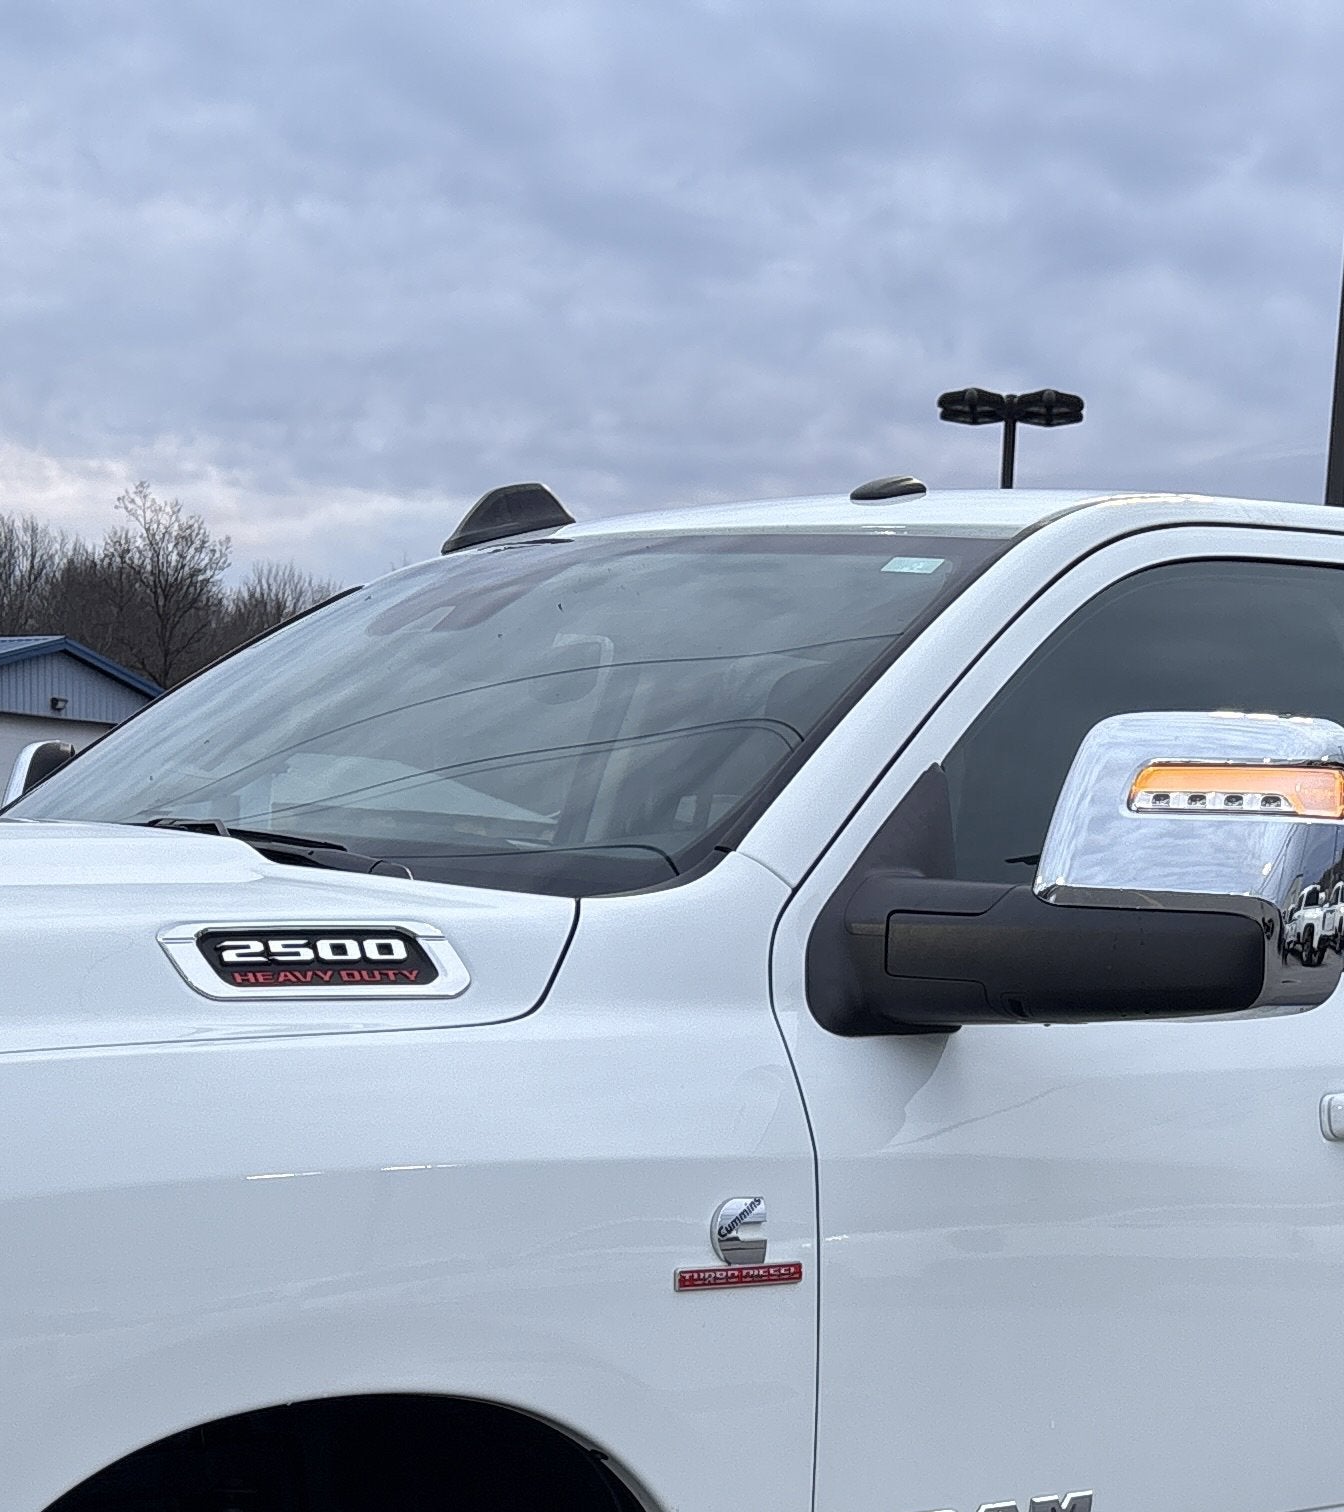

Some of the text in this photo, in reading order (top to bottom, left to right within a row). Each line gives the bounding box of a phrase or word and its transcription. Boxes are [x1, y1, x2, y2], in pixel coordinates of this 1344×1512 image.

[216, 938, 408, 963] 2500
[232, 969, 419, 984] HEAVY DUTY
[718, 1197, 762, 1239] Cummins
